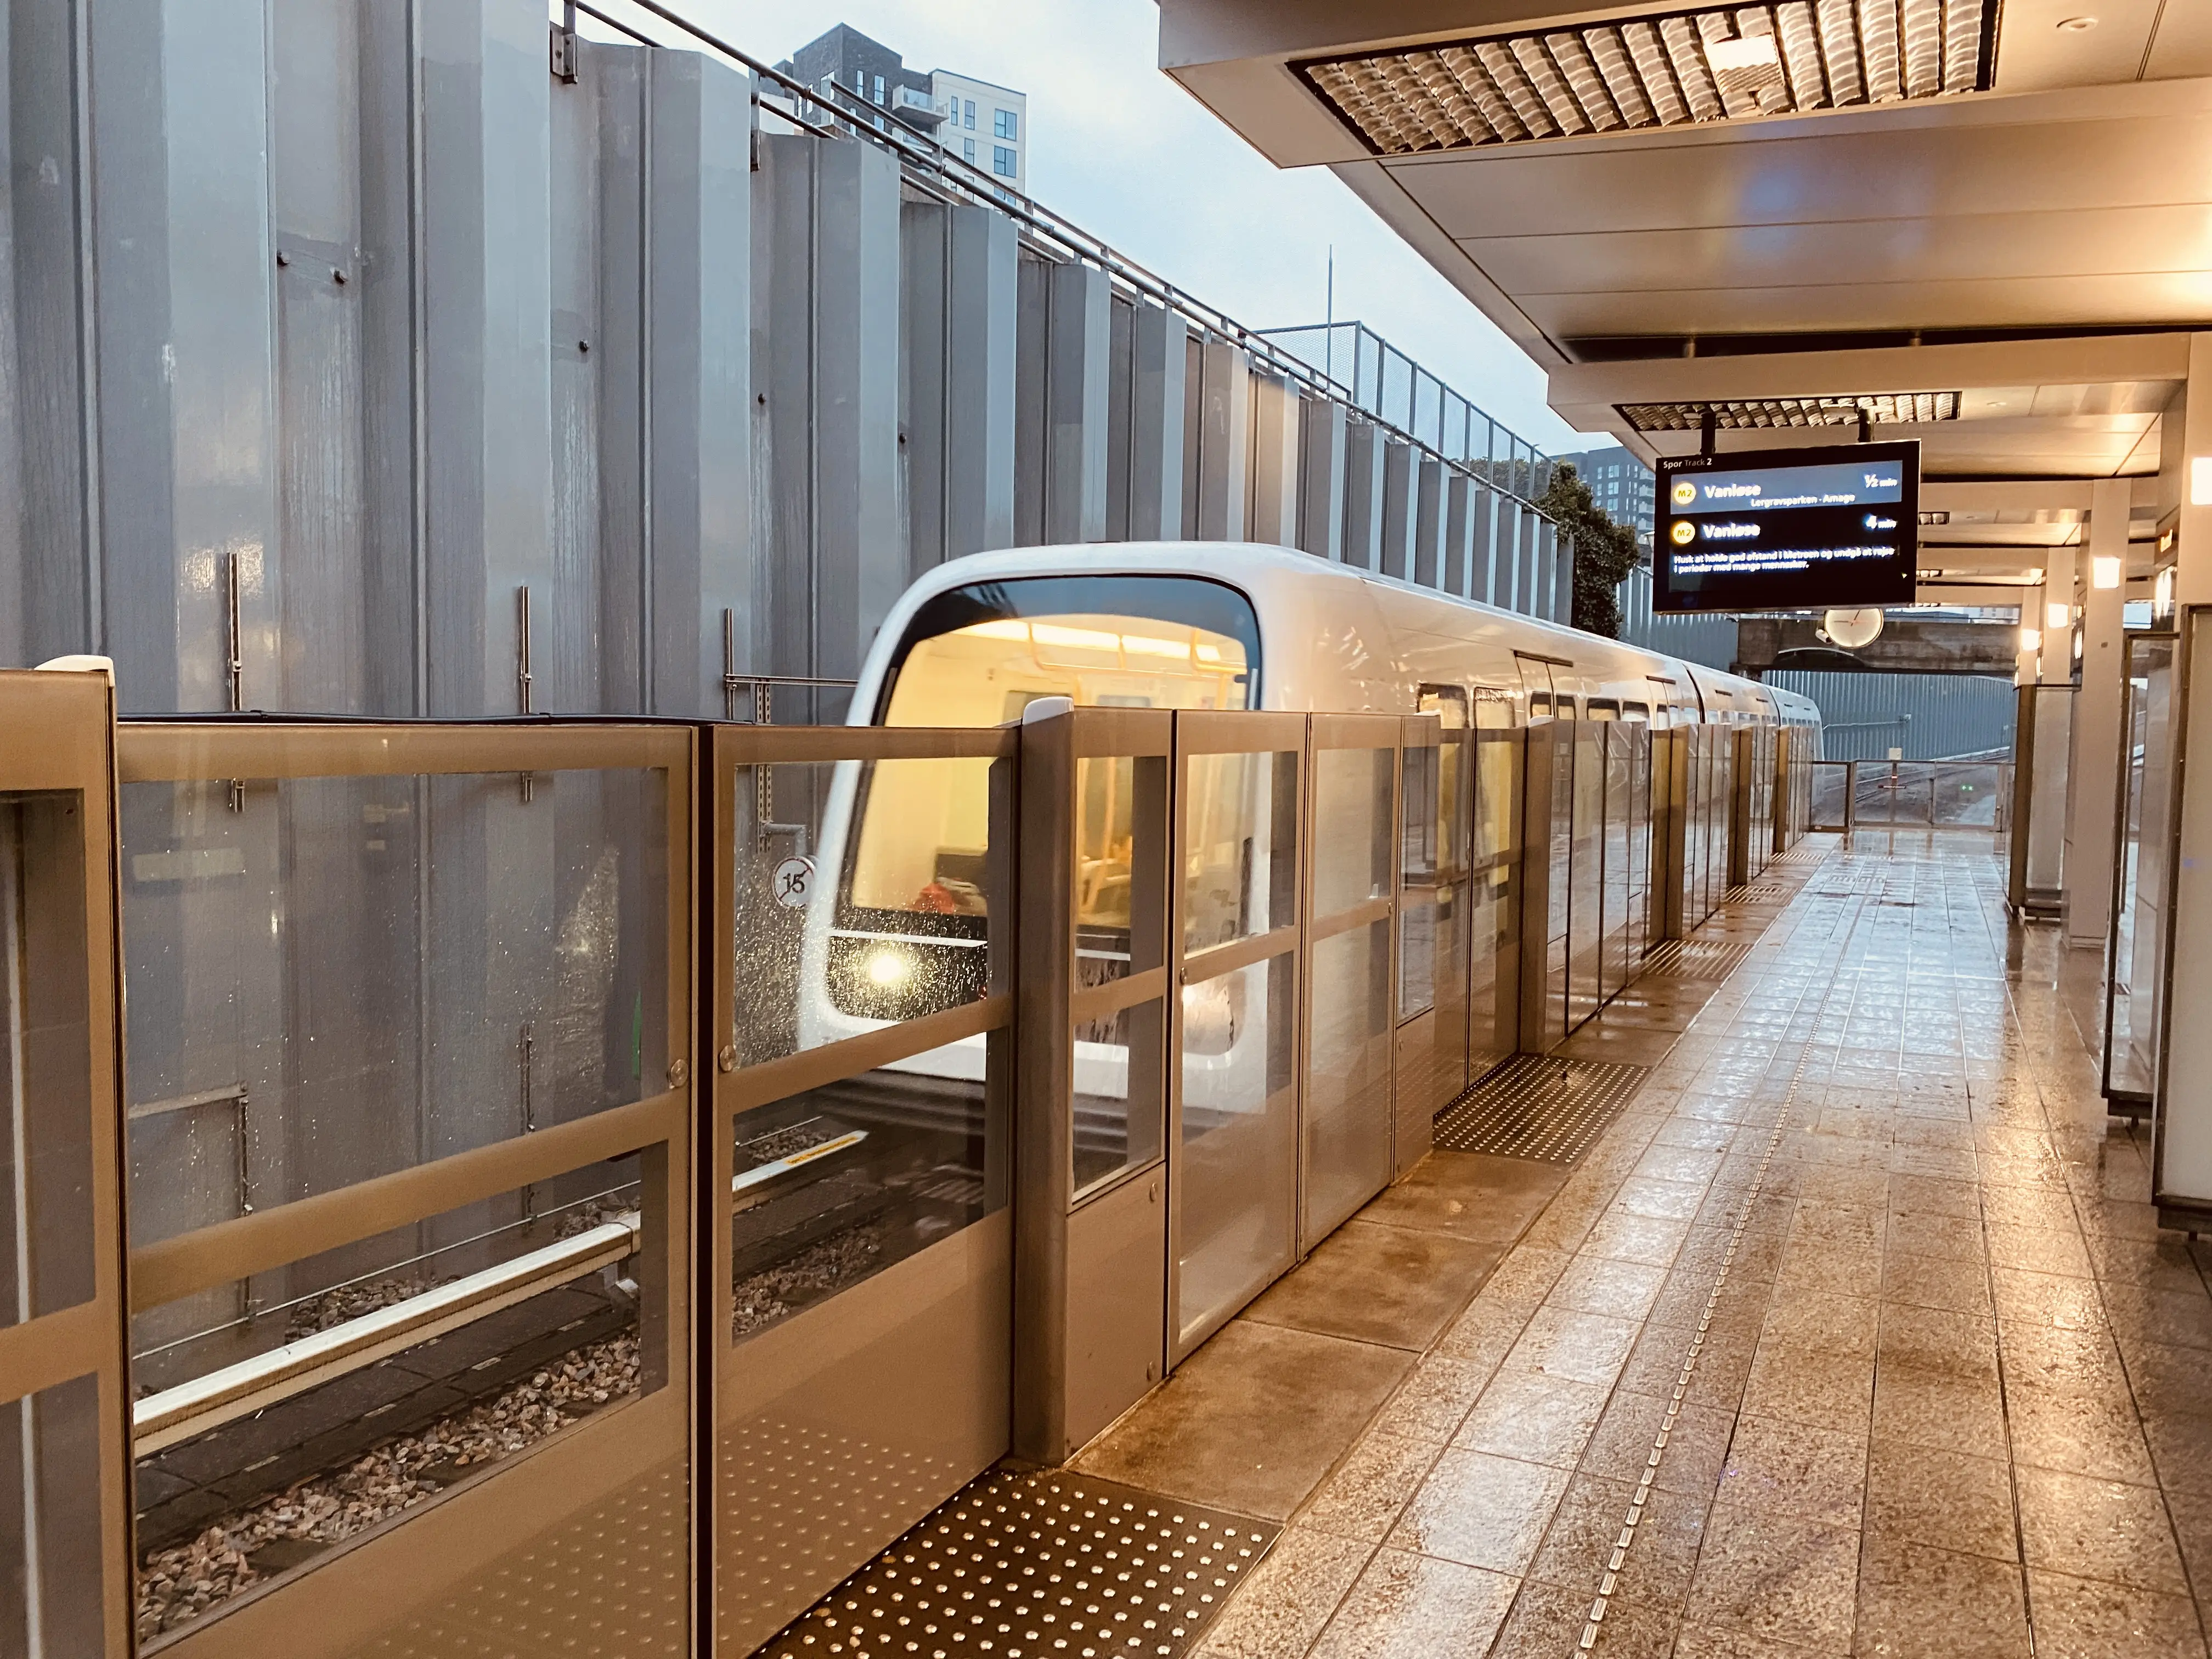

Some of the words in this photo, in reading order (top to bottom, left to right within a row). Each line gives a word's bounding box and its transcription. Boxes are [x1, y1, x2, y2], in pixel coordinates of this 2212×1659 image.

[1663, 460, 1683, 470] Spor
[1684, 459, 1705, 467] Track
[1707, 458, 1712, 466] 2
[1678, 489, 1692, 498] M2
[1880, 478, 1898, 487] min
[1866, 515, 1877, 529] 4
[1878, 520, 1897, 528] min
[1674, 555, 1694, 563] Husk
[1705, 554, 1728, 563] holde
[1729, 552, 1746, 563] god
[1820, 550, 1832, 560] og
[1713, 563, 1731, 572] med
[783, 873, 805, 894] 15
